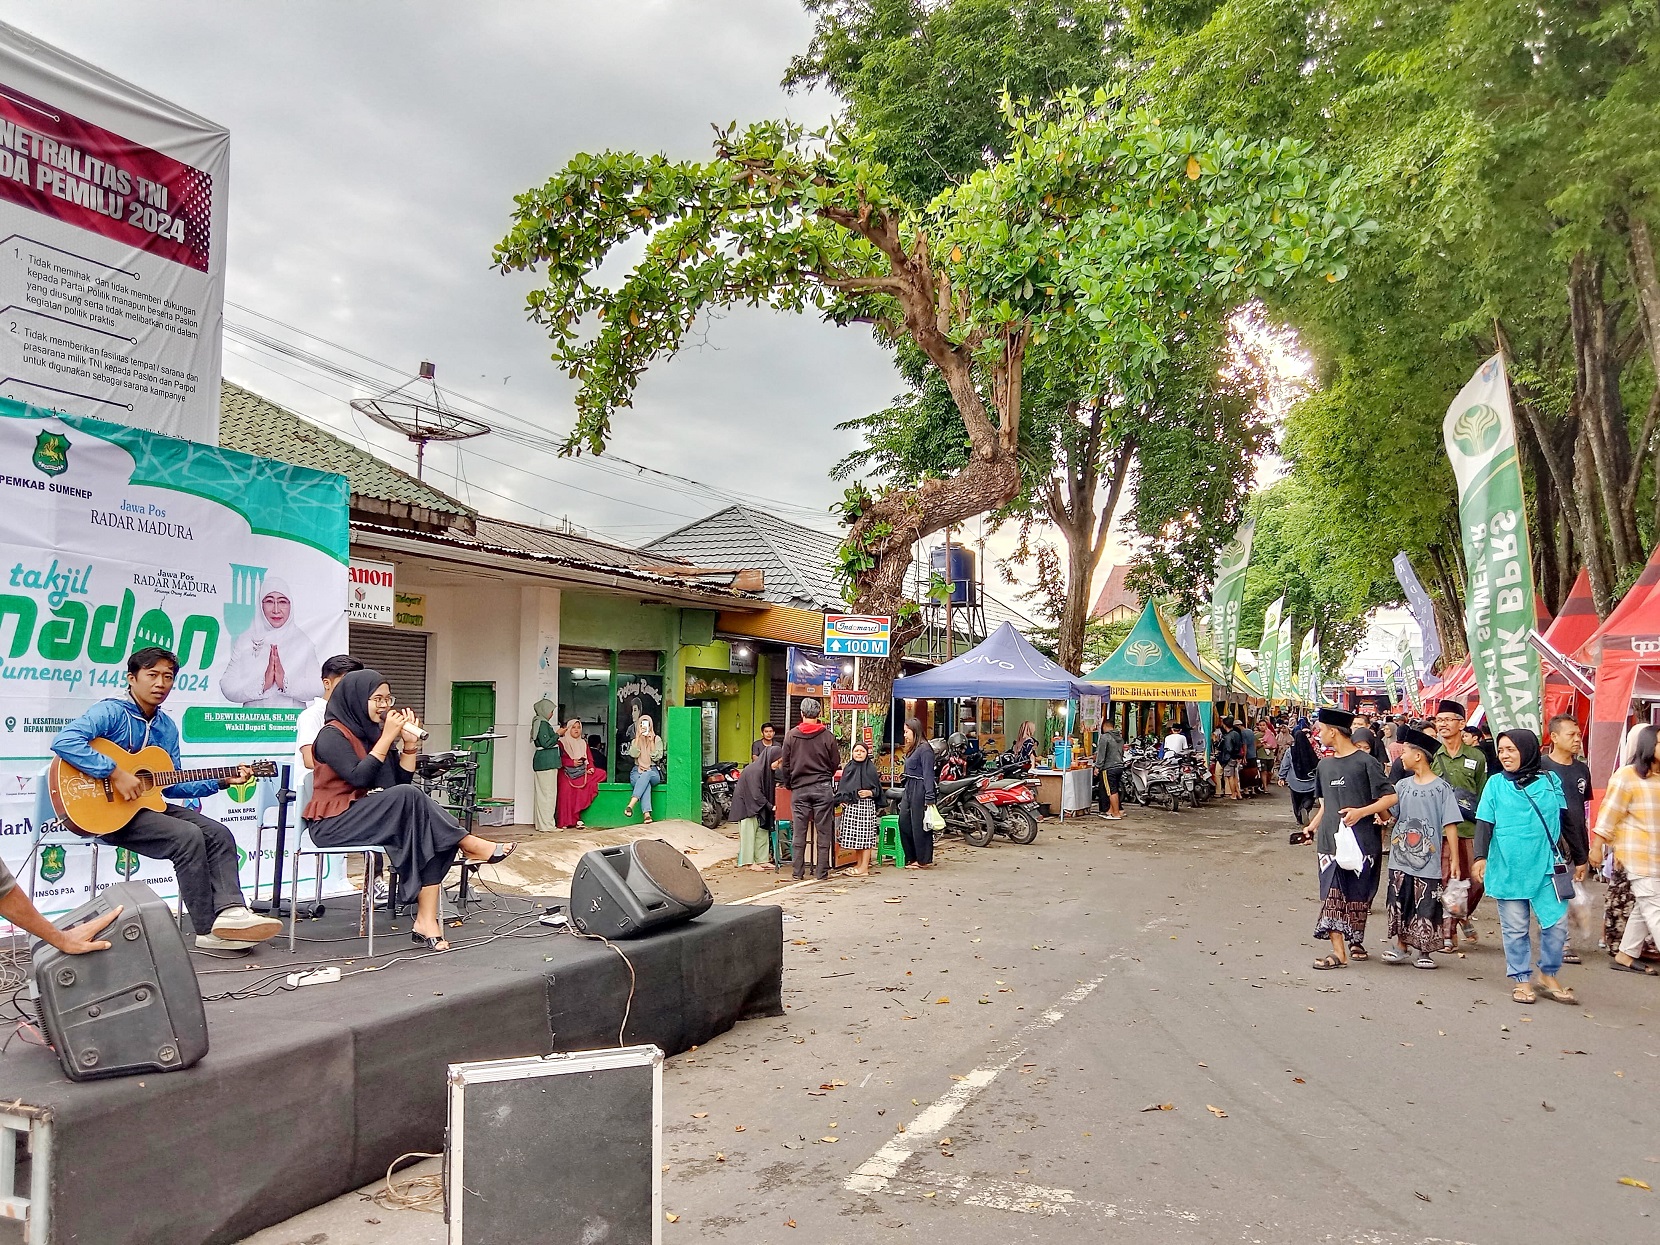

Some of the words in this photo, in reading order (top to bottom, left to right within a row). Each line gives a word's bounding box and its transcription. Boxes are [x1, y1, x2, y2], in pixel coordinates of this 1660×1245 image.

[0, 119, 131, 195] NETRALITAS
[137, 176, 167, 211] TNI
[37, 163, 124, 219] PEMILU
[129, 202, 185, 243] 2024
[14, 248, 22, 260] 1.
[28, 254, 51, 270] Tidak
[54, 264, 91, 282] memihak
[94, 277, 110, 289] dan
[111, 282, 129, 295] tidak
[130, 289, 161, 306] memberi
[163, 299, 196, 316] dukungan
[26, 293, 62, 311] kegiatan
[64, 306, 88, 319] politik
[27, 267, 58, 284] kepada
[61, 278, 85, 292] Partai
[87, 286, 110, 301] Politik
[112, 295, 146, 312] manapun
[147, 305, 173, 320] beserta
[175, 314, 198, 328] Paslon
[27, 282, 48, 296] yang
[50, 288, 82, 306] diusung
[84, 299, 104, 311] serta
[105, 304, 124, 317] tidak
[125, 311, 163, 329] melibatkan
[165, 324, 176, 333] diri
[177, 327, 199, 340] dalam
[10, 322, 20, 334] 2.
[24, 327, 48, 342] Tidak
[49, 336, 100, 356] memberikan
[101, 348, 129, 364] fasilitas
[161, 366, 185, 379] sarana
[186, 373, 199, 382] dan
[23, 342, 66, 360] prasarana
[67, 353, 87, 365] milik
[89, 357, 103, 369] TNI
[104, 362, 131, 376] kepada
[133, 369, 158, 383] Paslon
[159, 377, 173, 387] dan
[23, 355, 47, 367] untuk
[48, 361, 91, 378] digunakan
[92, 372, 122, 387] sebagai
[123, 380, 149, 393] sarana
[149, 386, 186, 403] kampanye
[0, 475, 46, 491] PEMKAB
[48, 483, 93, 500] SUMENEP
[120, 499, 145, 514] Jawa
[148, 504, 166, 518] Pos
[91, 509, 135, 531] RADAR
[137, 518, 194, 541] MADURA
[9, 559, 93, 606] takjil
[133, 573, 169, 589] RADAR
[172, 579, 217, 594] MADURA
[157, 569, 178, 579] Jawa
[180, 571, 195, 581] Pos
[349, 566, 393, 588] anon
[838, 622, 878, 632] Indomaret
[844, 640, 869, 653] 100
[871, 641, 884, 653] M
[963, 655, 1015, 670] vivo
[172, 673, 209, 691] 024
[1131, 687, 1159, 696] BHAKTI
[1162, 688, 1197, 697] SUMEKAR
[215, 713, 234, 721] DEWI
[225, 723, 244, 731] Wakil
[245, 724, 266, 732] Bupati
[269, 724, 298, 732] Sumenep
[220, 815, 239, 823] BHAKTI
[60, 887, 75, 895] P3A
